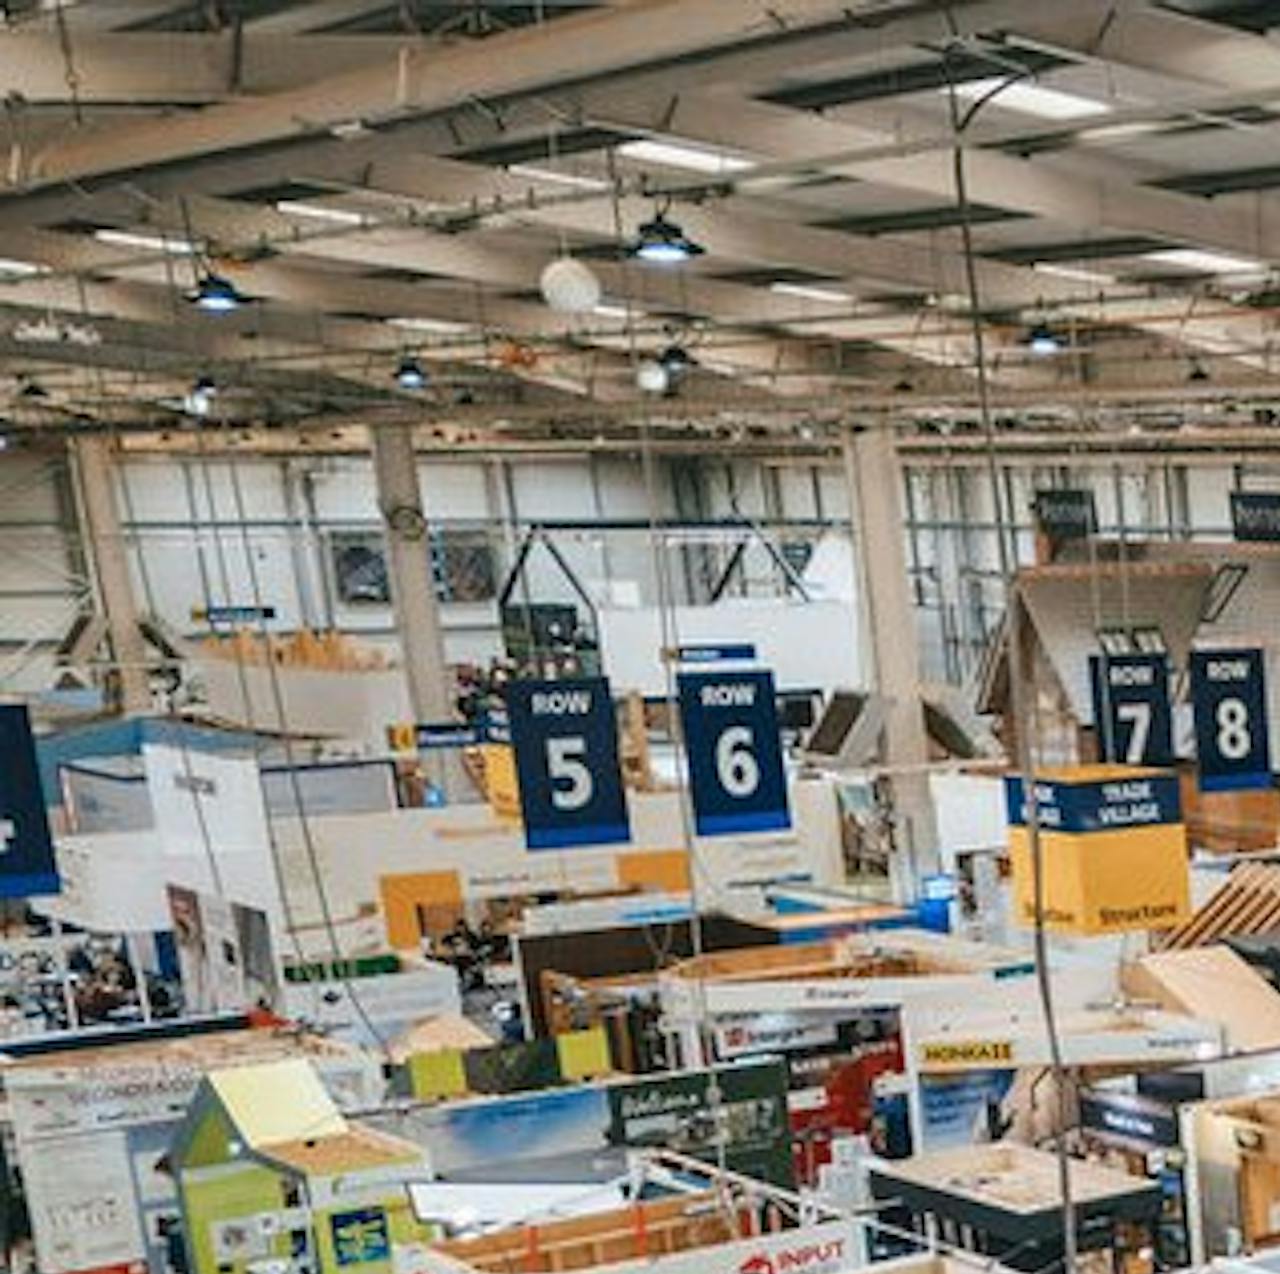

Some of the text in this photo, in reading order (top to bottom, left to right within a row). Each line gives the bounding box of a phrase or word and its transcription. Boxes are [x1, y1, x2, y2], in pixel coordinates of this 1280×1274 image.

[1110, 665, 1153, 686] ROW
[1207, 661, 1249, 682] ROW
[531, 690, 593, 715] ROW
[701, 684, 756, 706] ROW
[1117, 702, 1151, 763] 7
[1217, 697, 1251, 759] 8
[715, 725, 760, 797] 6
[546, 737, 592, 810] 5
[1101, 782, 1151, 803] TRADE
[1098, 803, 1160, 824] VILLAGE
